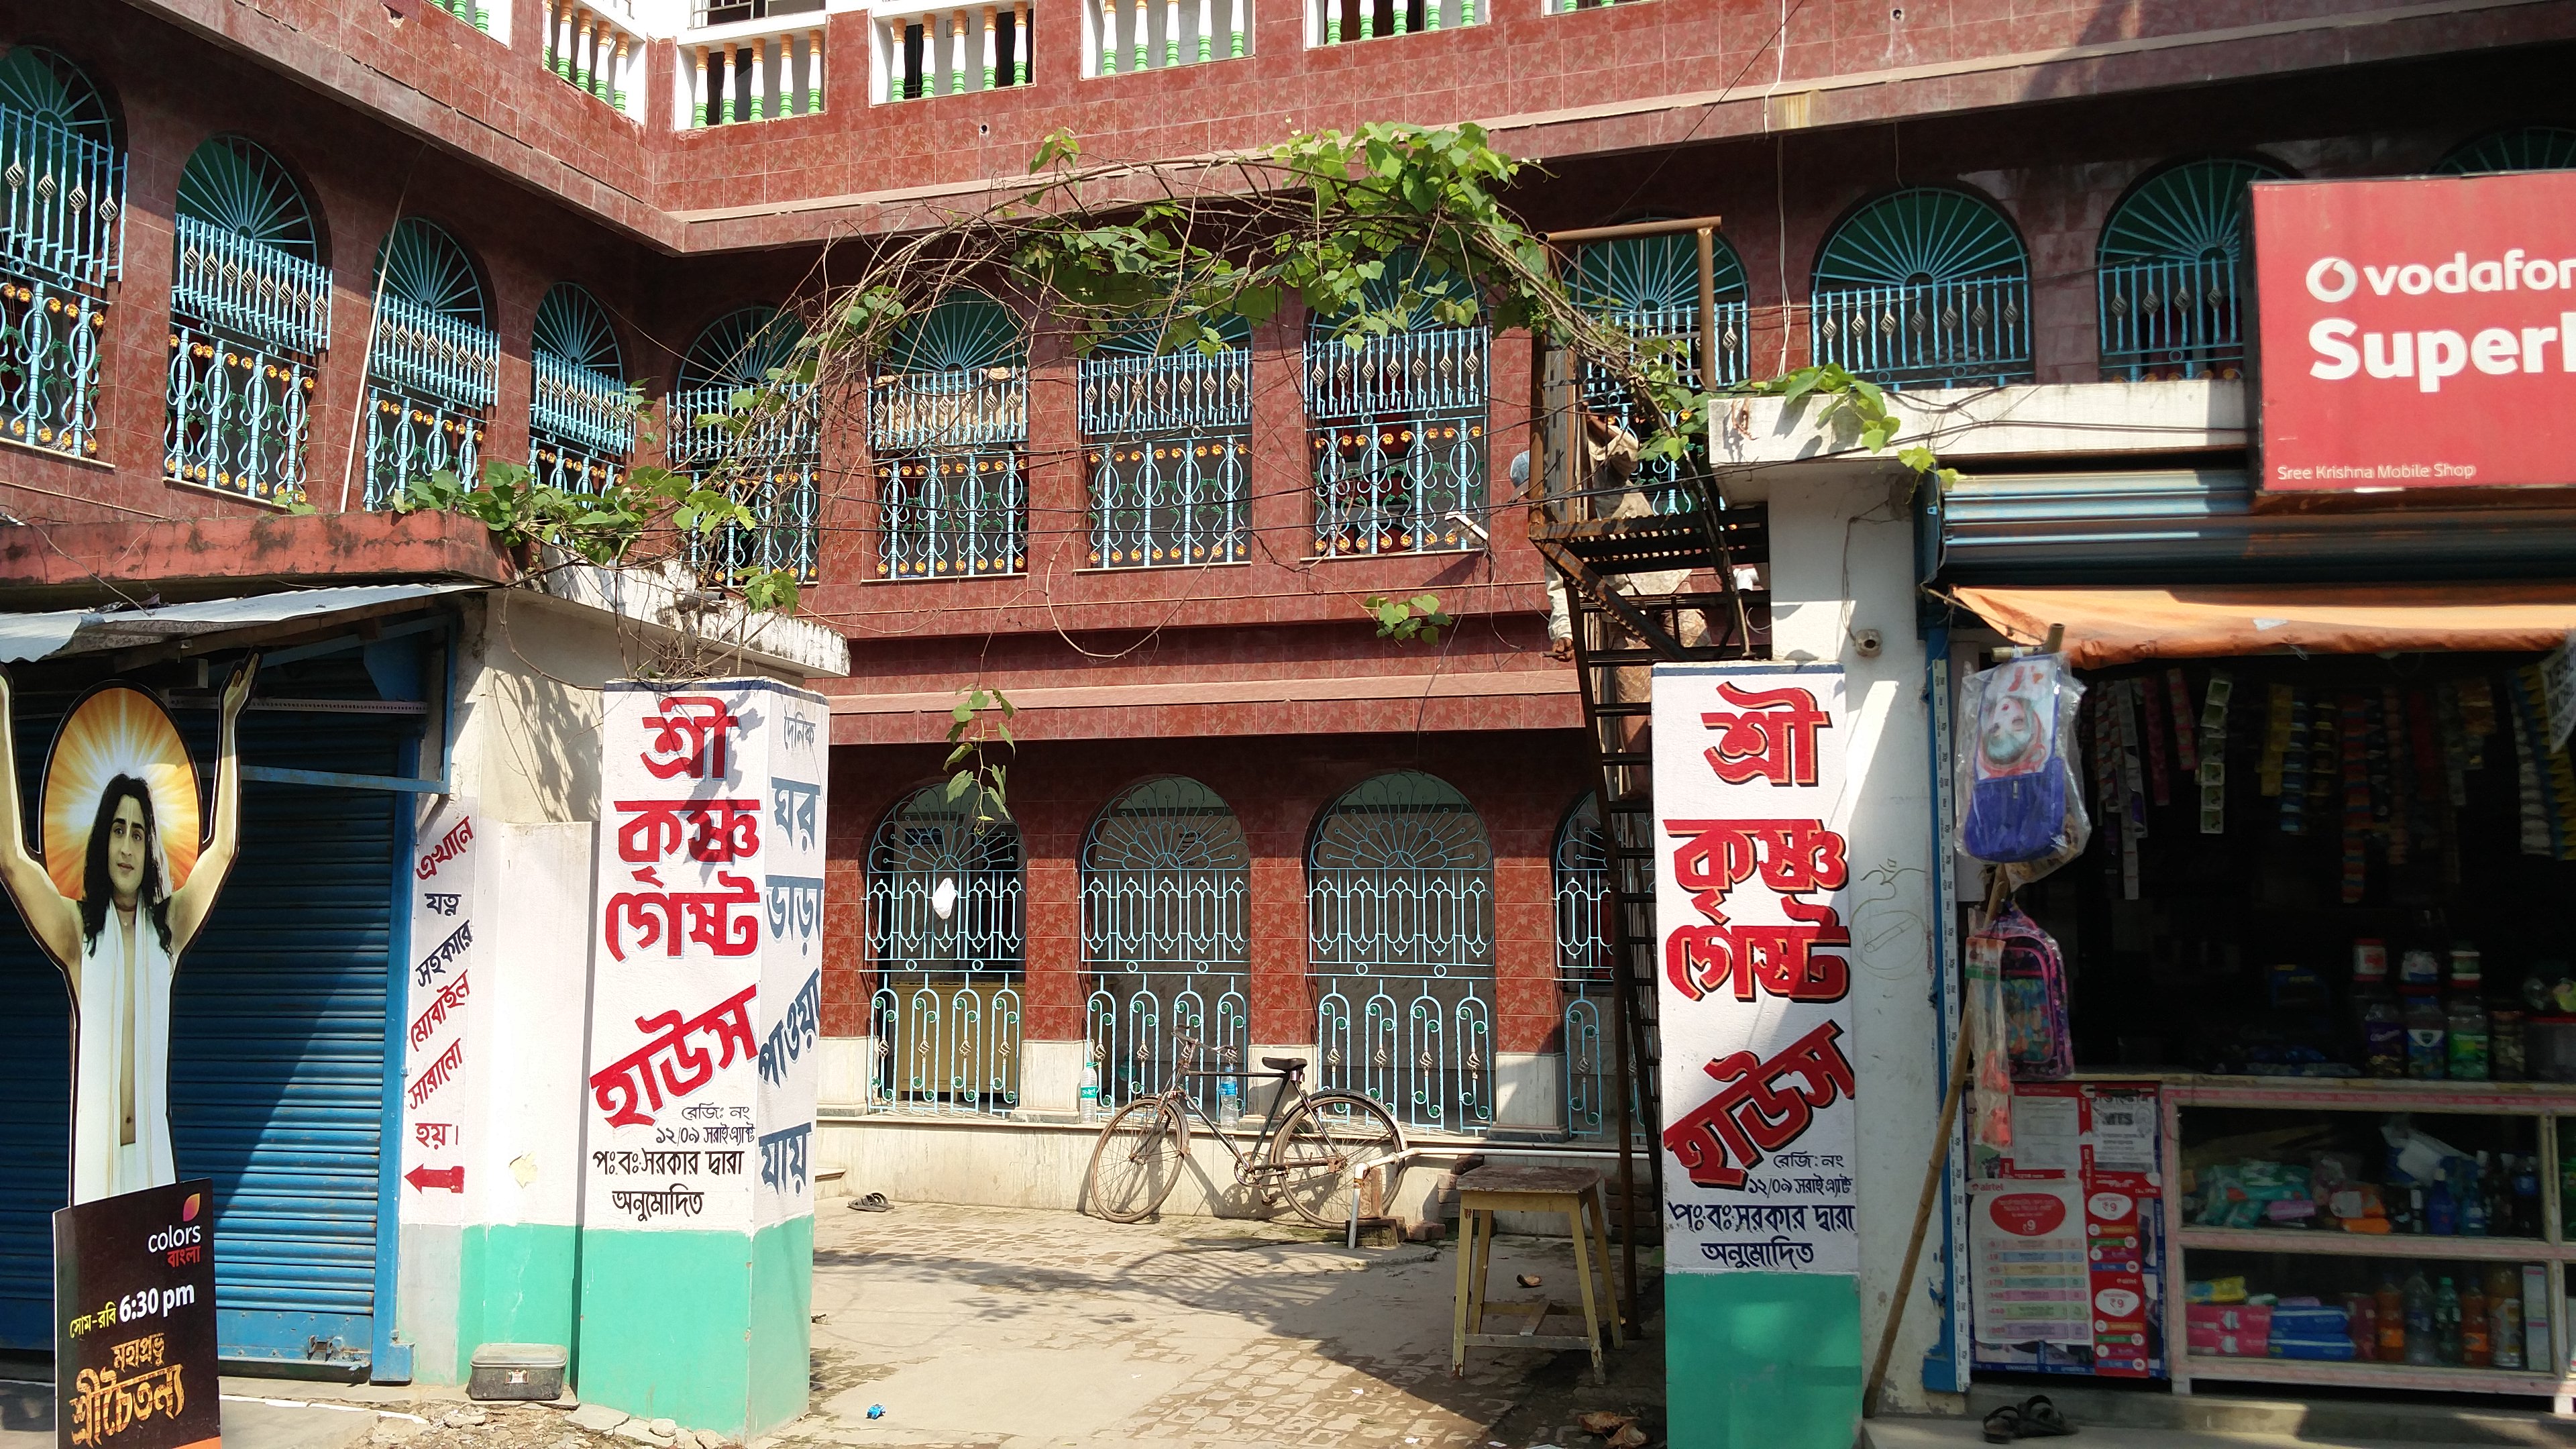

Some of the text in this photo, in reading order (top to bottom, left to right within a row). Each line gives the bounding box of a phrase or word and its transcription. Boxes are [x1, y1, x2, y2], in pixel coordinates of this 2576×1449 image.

[2277, 463, 2477, 480] Sree Krishna Mobile Shop
[641, 696, 739, 780] শ্রী
[1701, 680, 1830, 787] শ্রী
[415, 816, 474, 881] এখানে
[614, 799, 761, 886] কৃষ্ণ
[771, 776, 820, 852] ঘর
[425, 892, 462, 916] যত্ন
[1662, 818, 1849, 924] কৃষ্ণ
[765, 875, 824, 955] ভাড়া
[415, 919, 474, 988] সহকারে
[411, 968, 470, 1053] মোবাইল
[759, 967, 820, 1089] পাওয়া
[409, 1038, 463, 1111] সারানো
[590, 983, 759, 1130] হাউস
[1664, 1019, 1855, 1191] হাউস
[759, 1122, 812, 1196] যায়
[1980, 1183, 2004, 1192] airtel
[148, 1224, 201, 1253] colors
[612, 1183, 704, 1222] অনুমোদিত
[167, 1246, 201, 1268] বাংলা
[1701, 1235, 1814, 1269] অনুমোদিত
[119, 1288, 159, 1324] 6:30
[163, 1284, 195, 1317] pm
